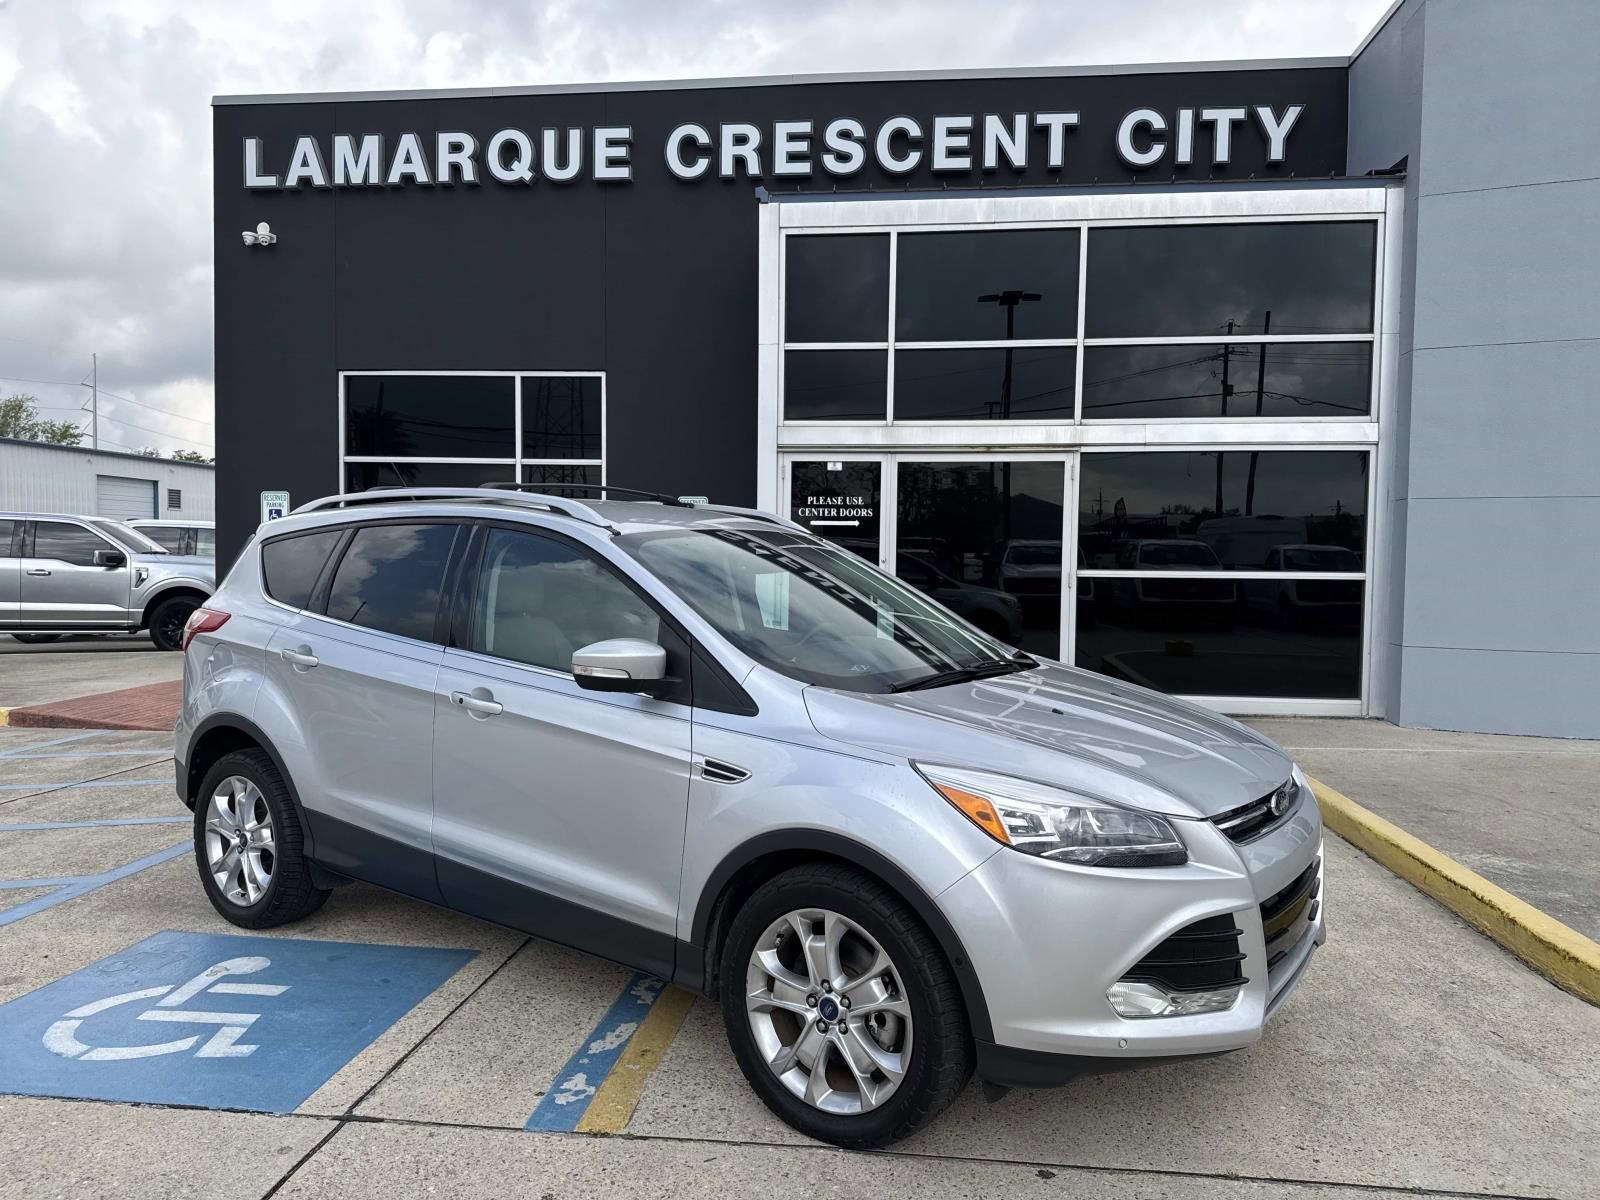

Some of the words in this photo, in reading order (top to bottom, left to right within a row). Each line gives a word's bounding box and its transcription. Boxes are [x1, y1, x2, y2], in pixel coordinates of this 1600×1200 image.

[243, 126, 633, 188] LAMARQUE
[665, 111, 1080, 181] CRESCENT
[1117, 104, 1305, 168] CITY
[807, 496, 844, 505] PLEASE
[846, 496, 865, 505] USE
[798, 507, 838, 517] CENTER
[839, 507, 873, 517] DOORS
